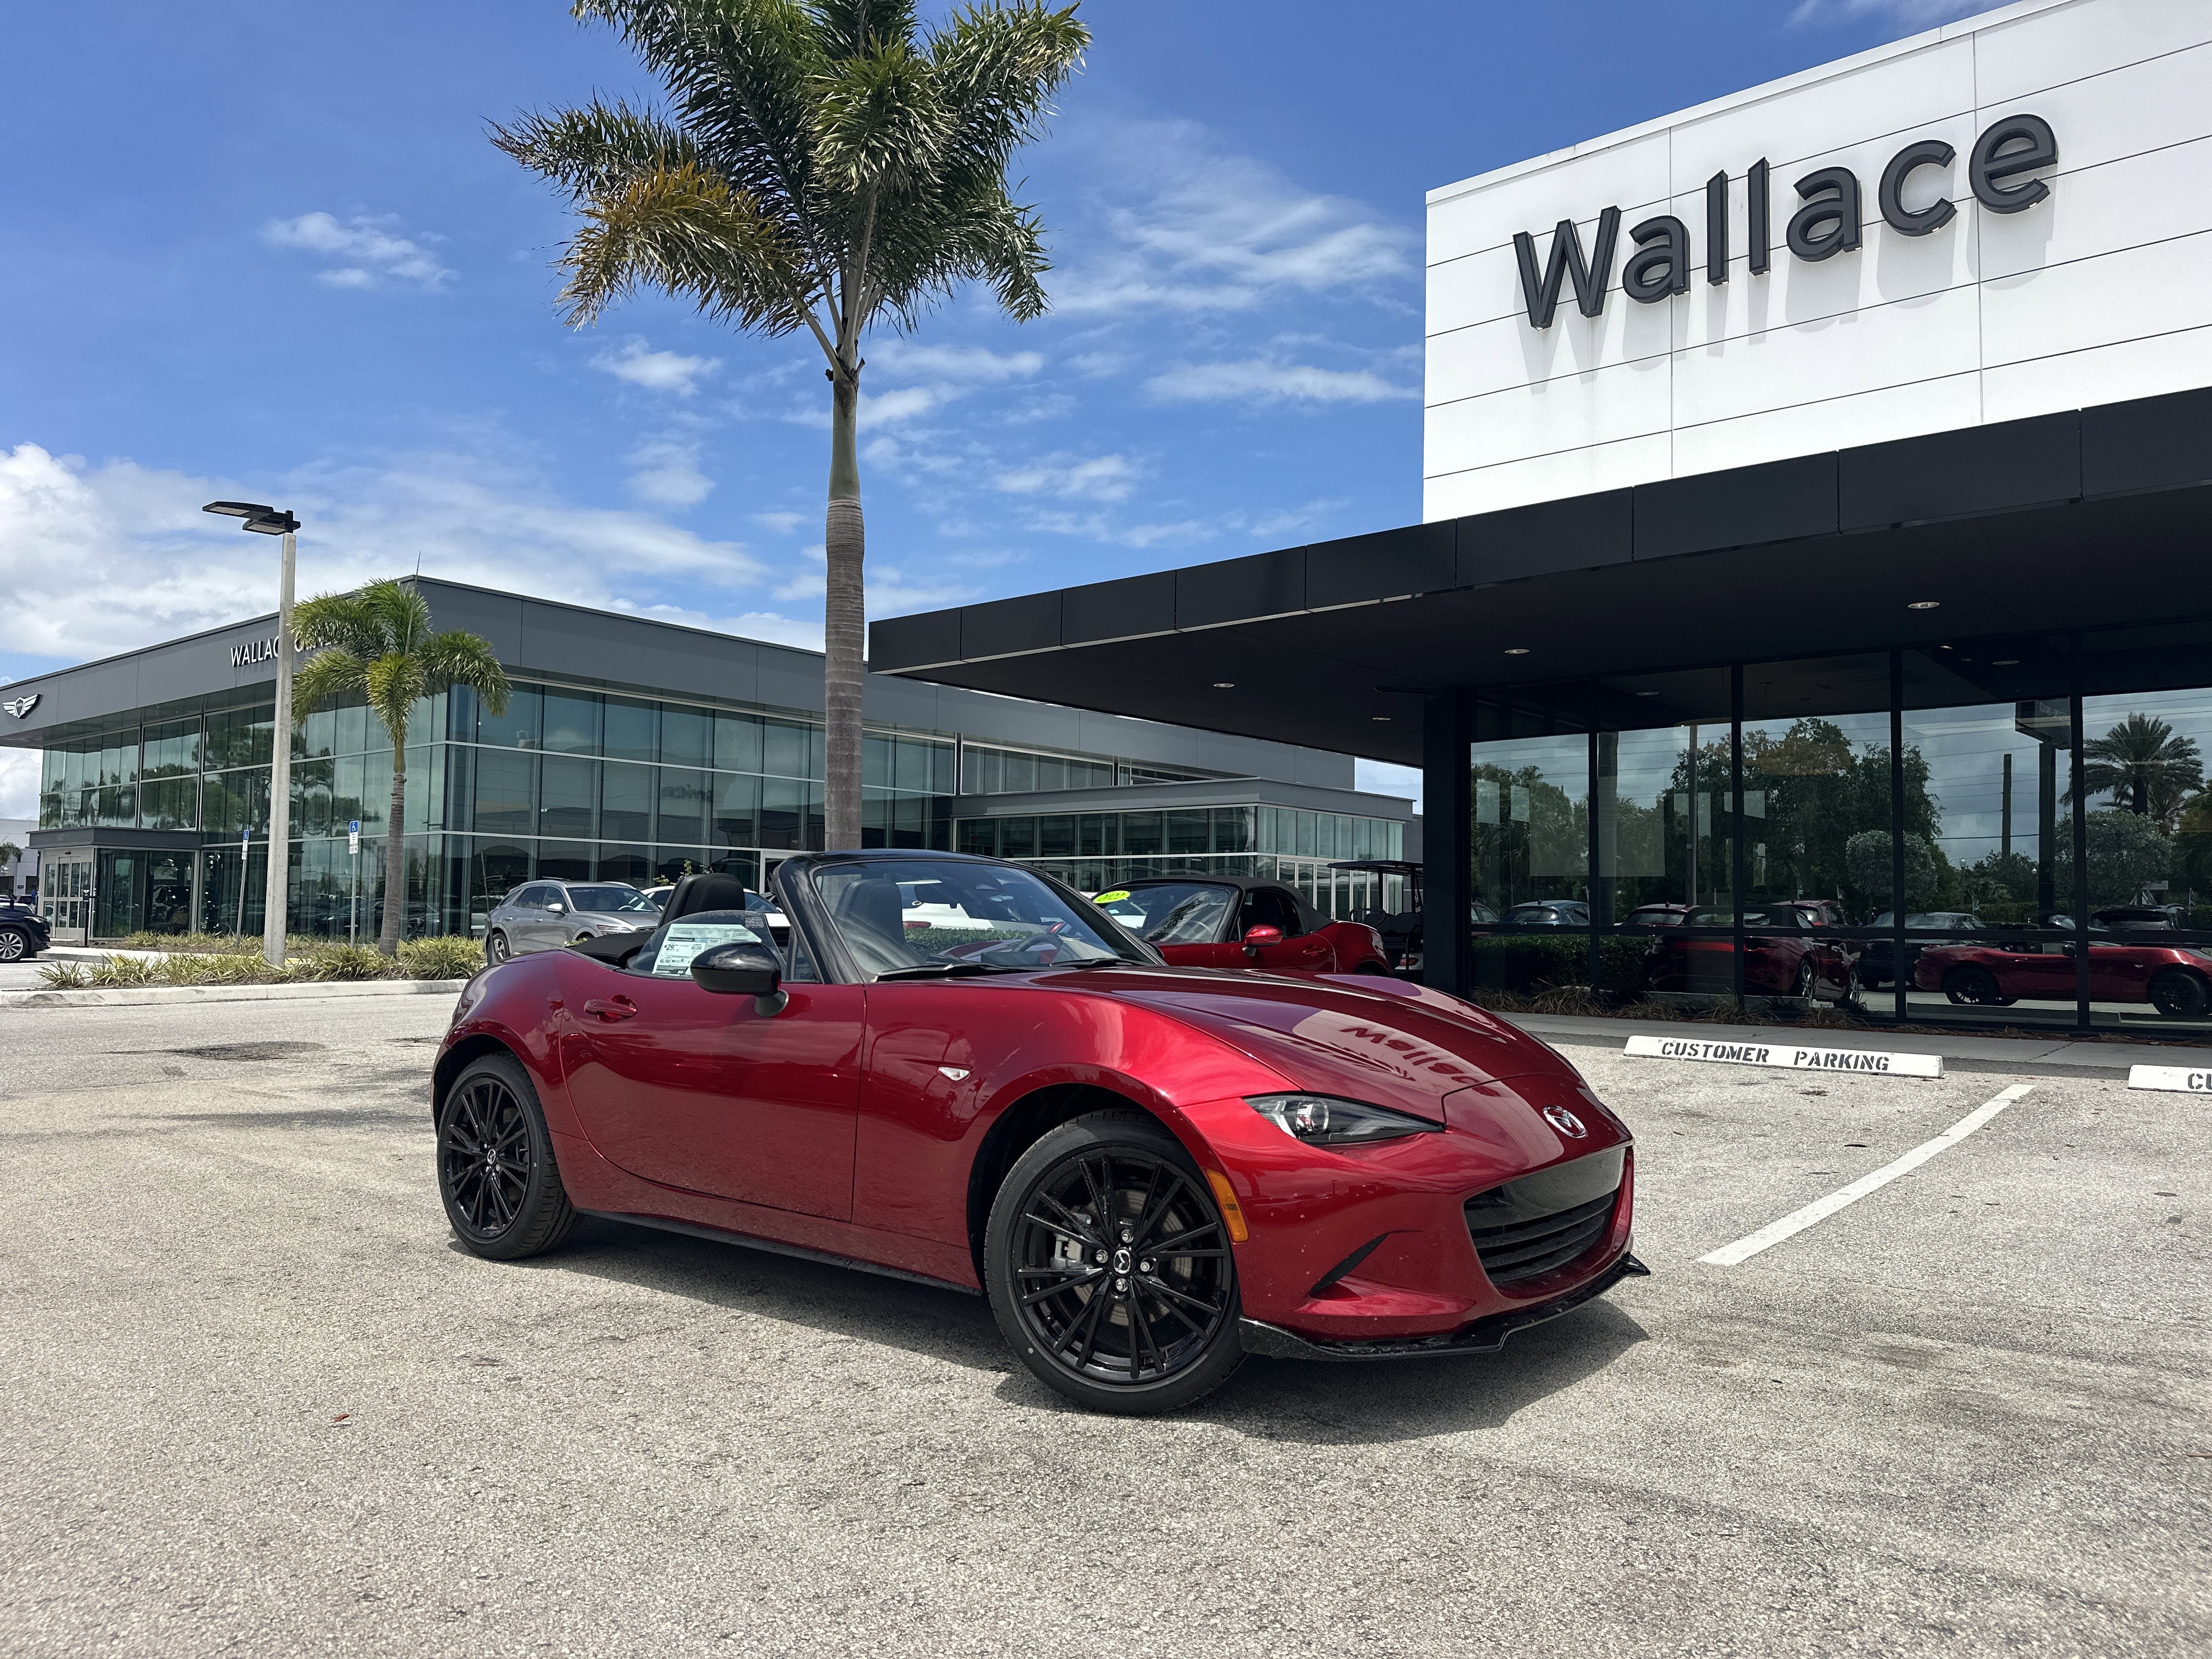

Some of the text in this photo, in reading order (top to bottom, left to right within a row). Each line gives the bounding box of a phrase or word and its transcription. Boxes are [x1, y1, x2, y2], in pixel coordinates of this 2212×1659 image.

[1513, 114, 2058, 330] Wallace
[230, 635, 279, 668] WALLAC
[1661, 1042, 1890, 1071] CUSTOMER PARKING
